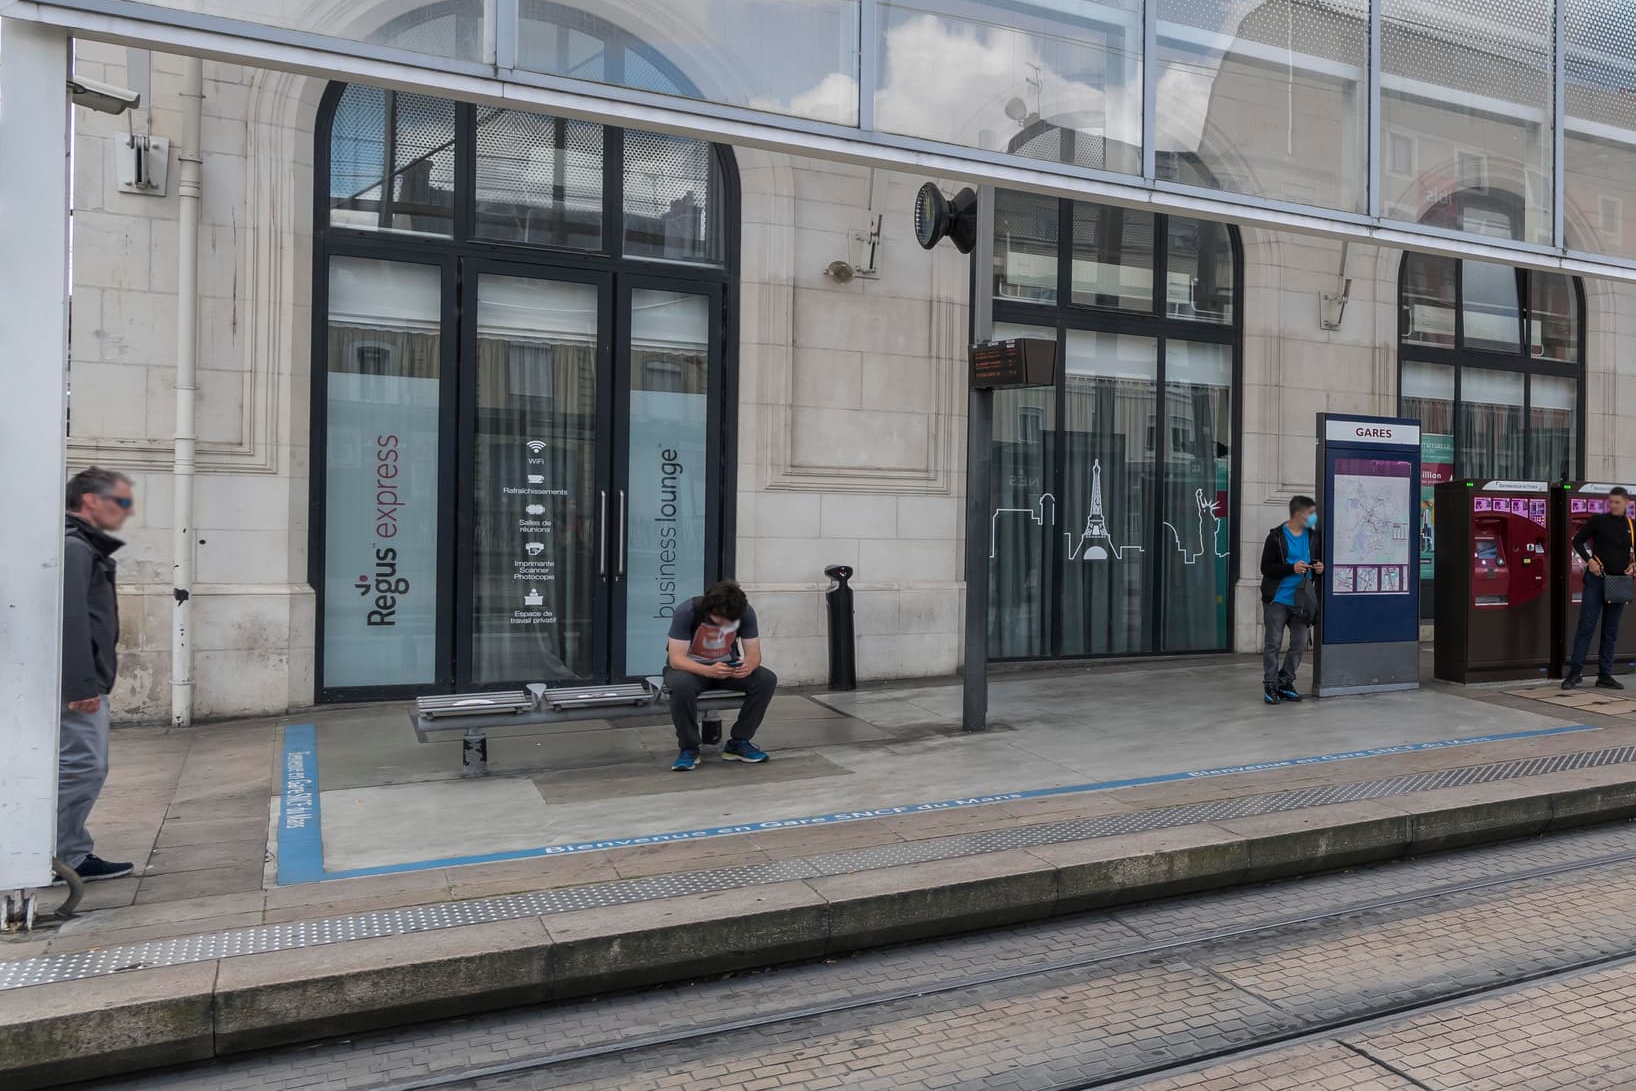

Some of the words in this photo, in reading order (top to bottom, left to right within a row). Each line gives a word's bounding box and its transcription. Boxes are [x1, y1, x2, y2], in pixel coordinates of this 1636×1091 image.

[1355, 427, 1392, 438] GARES
[376, 435, 406, 538] express
[655, 448, 684, 522] lounge
[513, 573, 556, 581] Photocopie
[652, 527, 677, 619] business
[367, 547, 410, 626] Regus
[1187, 761, 1291, 777] Bienvenue
[1321, 751, 1366, 760] Gare
[287, 779, 312, 794] Gare
[286, 793, 312, 807] SNCF
[286, 814, 312, 829] Mans
[545, 830, 707, 854] Bienvenue
[717, 825, 751, 834] en
[759, 817, 826, 828] Gare
[834, 807, 908, 821] SNCF
[917, 802, 949, 811] du
[955, 794, 1023, 806] Mans
